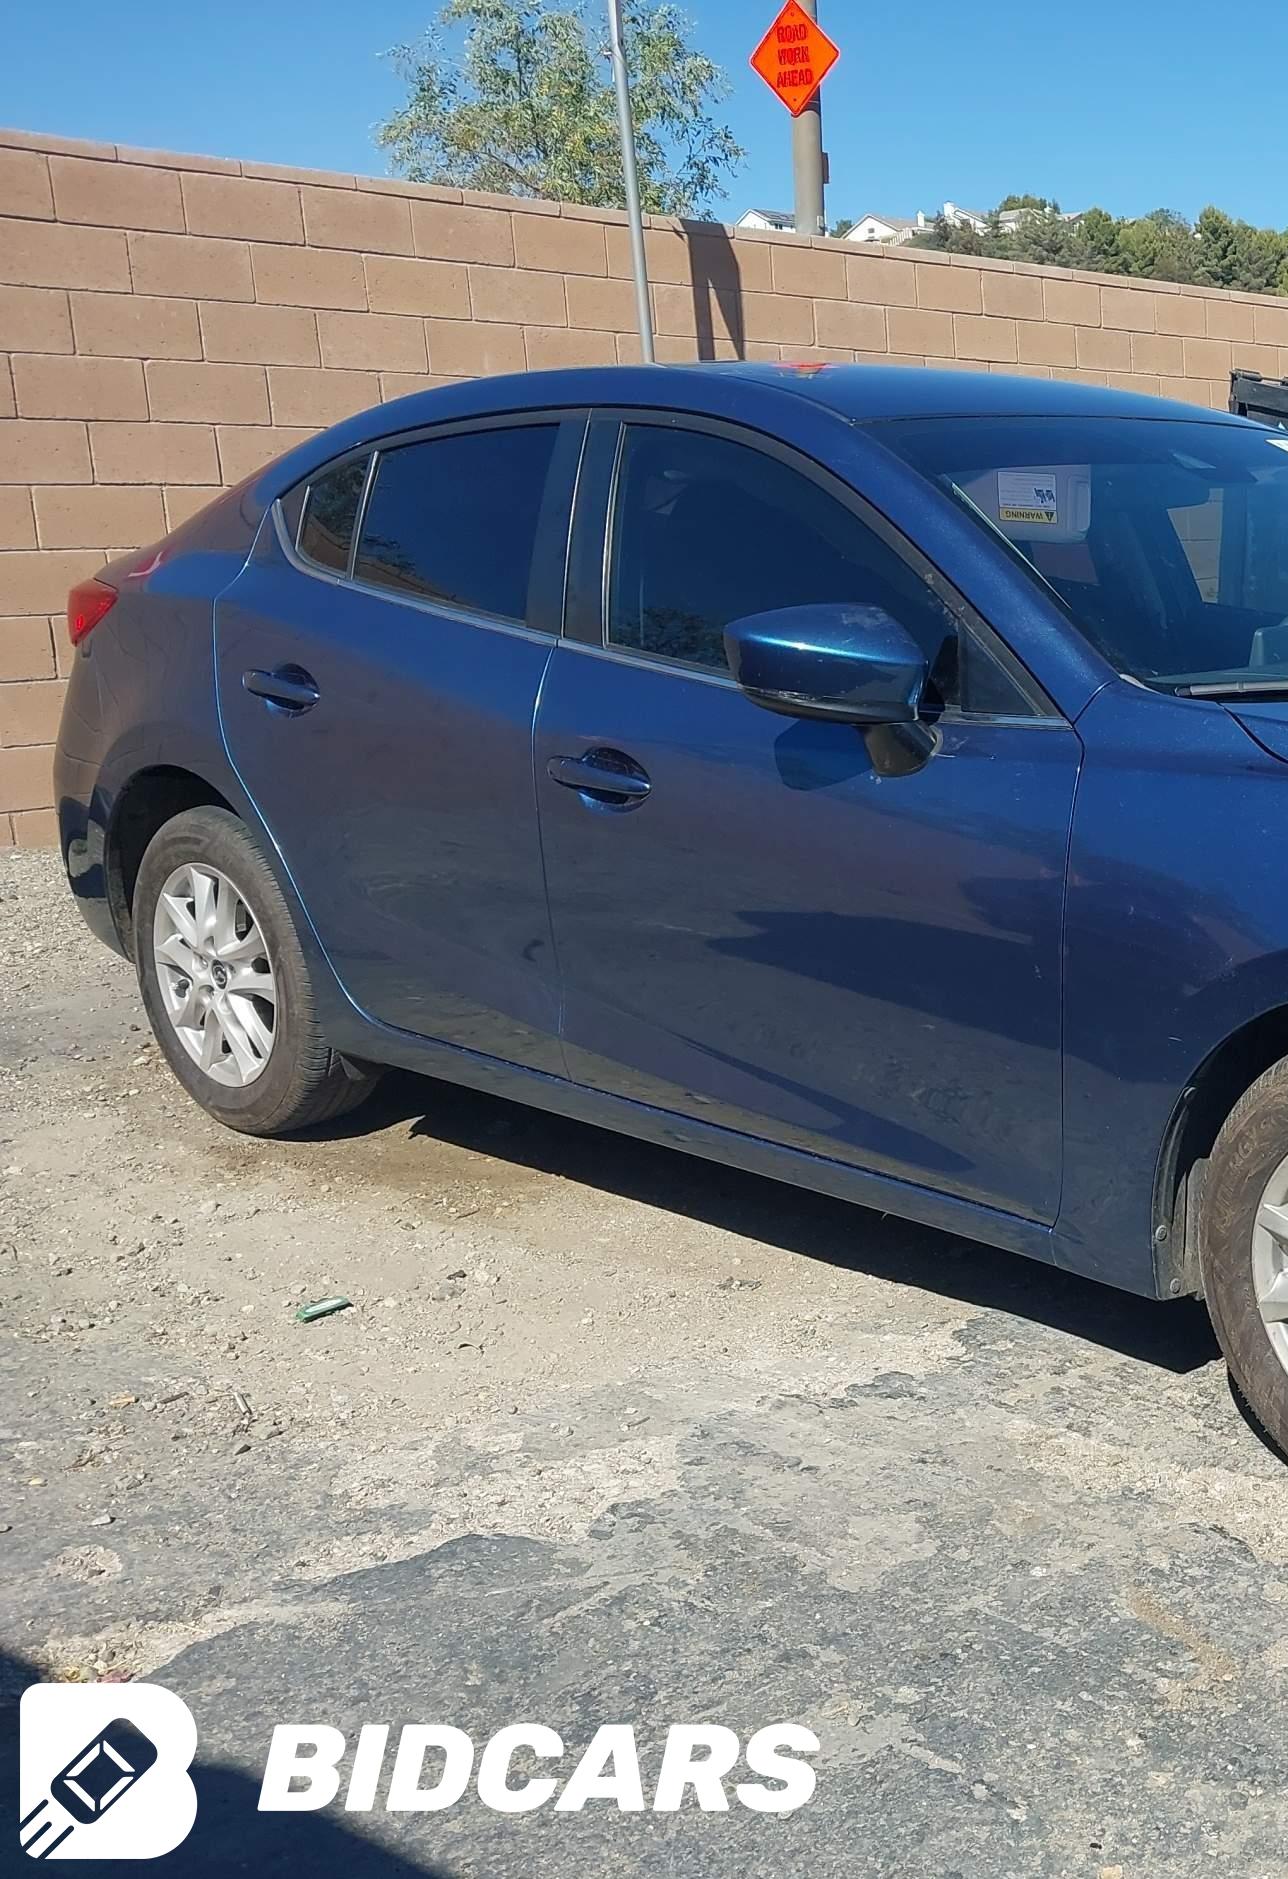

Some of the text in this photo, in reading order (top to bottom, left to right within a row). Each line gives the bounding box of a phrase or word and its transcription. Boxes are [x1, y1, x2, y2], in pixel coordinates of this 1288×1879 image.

[777, 24, 807, 43] ROAD
[777, 69, 814, 88] AHEAD
[1005, 510, 1044, 520] WARNING
